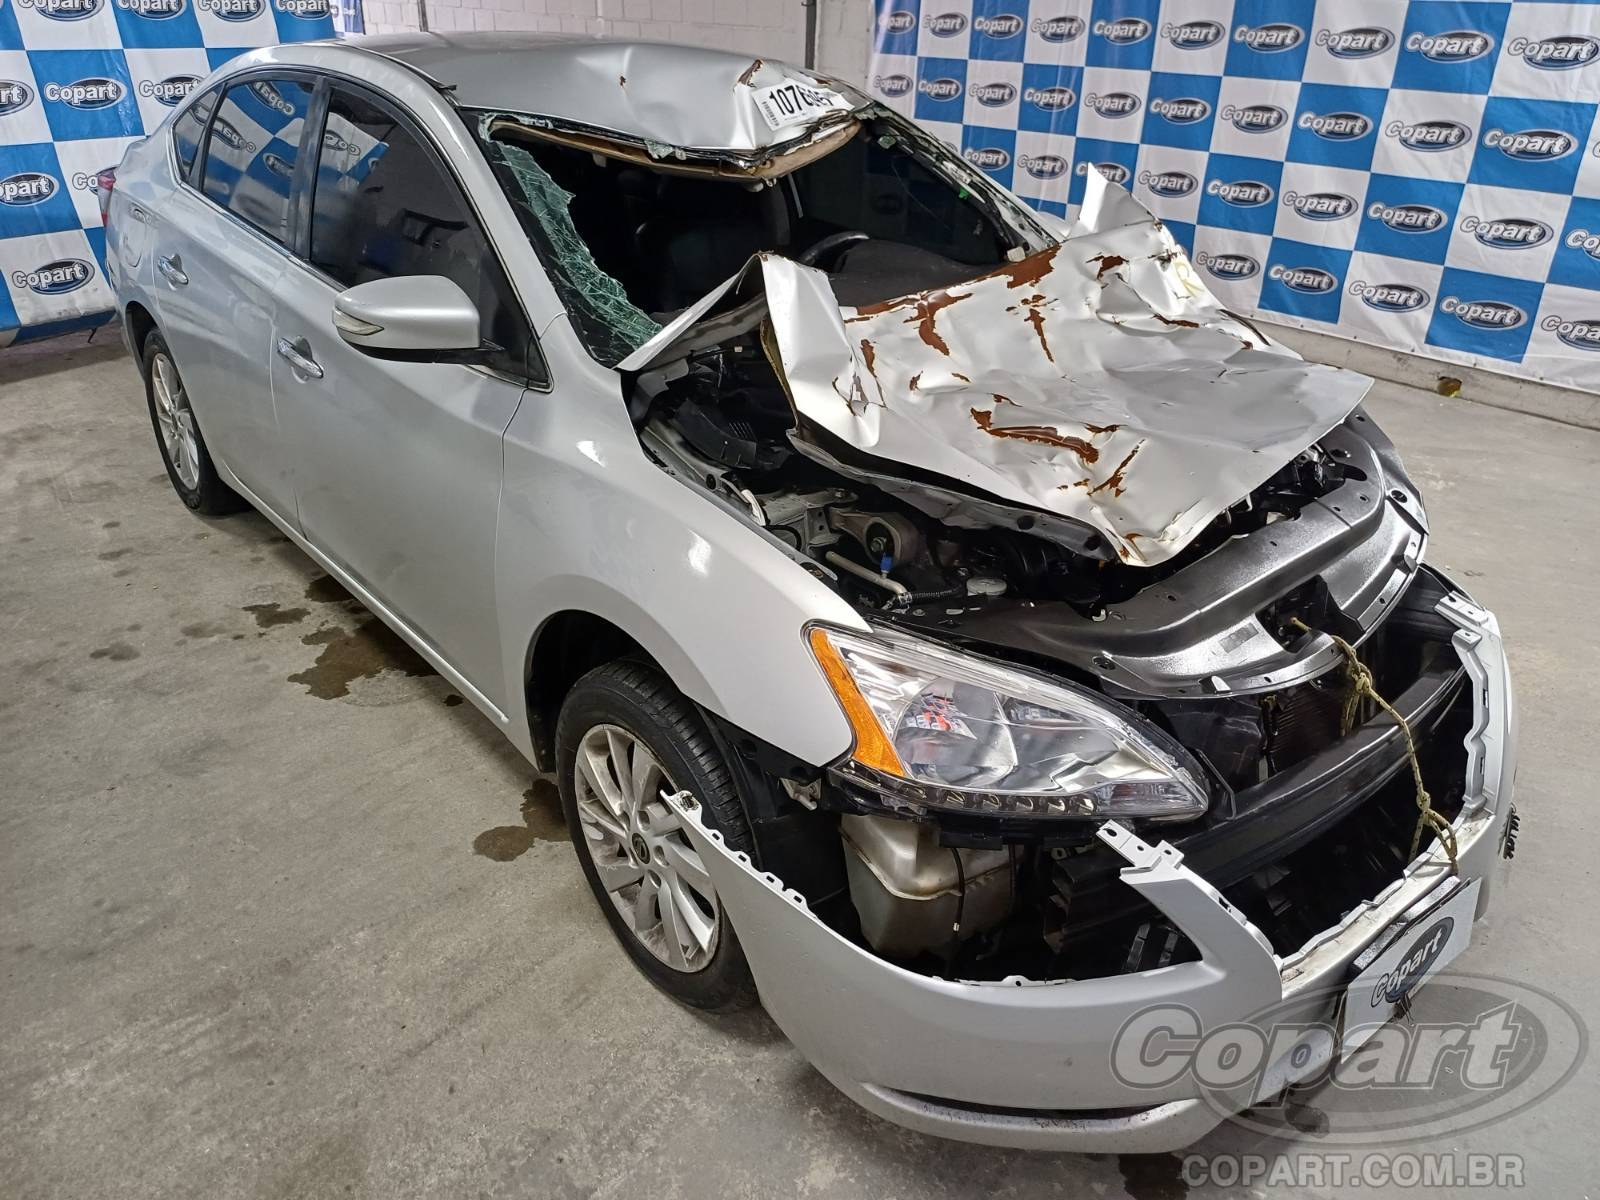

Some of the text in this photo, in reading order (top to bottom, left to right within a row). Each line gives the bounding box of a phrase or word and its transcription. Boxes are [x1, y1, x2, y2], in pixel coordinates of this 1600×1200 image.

[974, 15, 1018, 36] Copart
[1031, 19, 1080, 38] Copart
[1093, 19, 1145, 41] Copart
[1160, 22, 1217, 45] Copart
[1233, 26, 1298, 49] Copart
[1315, 29, 1386, 55] Copart
[1405, 33, 1488, 57] Copart
[1508, 37, 1599, 65] Copart
[44, 81, 118, 105] Copart
[873, 75, 908, 93] Copart
[918, 79, 957, 97] Copart
[969, 84, 1012, 104] Copart
[1024, 88, 1072, 107] Copart
[1084, 93, 1135, 114] Copart
[1150, 99, 1203, 120] Copart
[1221, 105, 1280, 128] Copart
[1298, 111, 1365, 135] Copart
[1385, 121, 1462, 147] Copart
[1484, 127, 1569, 155] Copart
[964, 149, 1003, 168] Copart
[1017, 154, 1063, 177] Copart
[1138, 170, 1193, 195] Copart
[1207, 180, 1269, 205] Copart
[1283, 191, 1350, 217] Copart
[1367, 201, 1440, 229] Copart
[1459, 216, 1545, 246] Copart
[12, 262, 83, 289] Copart
[1197, 252, 1253, 276] Copart
[1268, 264, 1331, 290] Copart
[1349, 281, 1421, 310] Copart
[1440, 297, 1523, 326] Copart
[1371, 928, 1443, 1008] Copart
